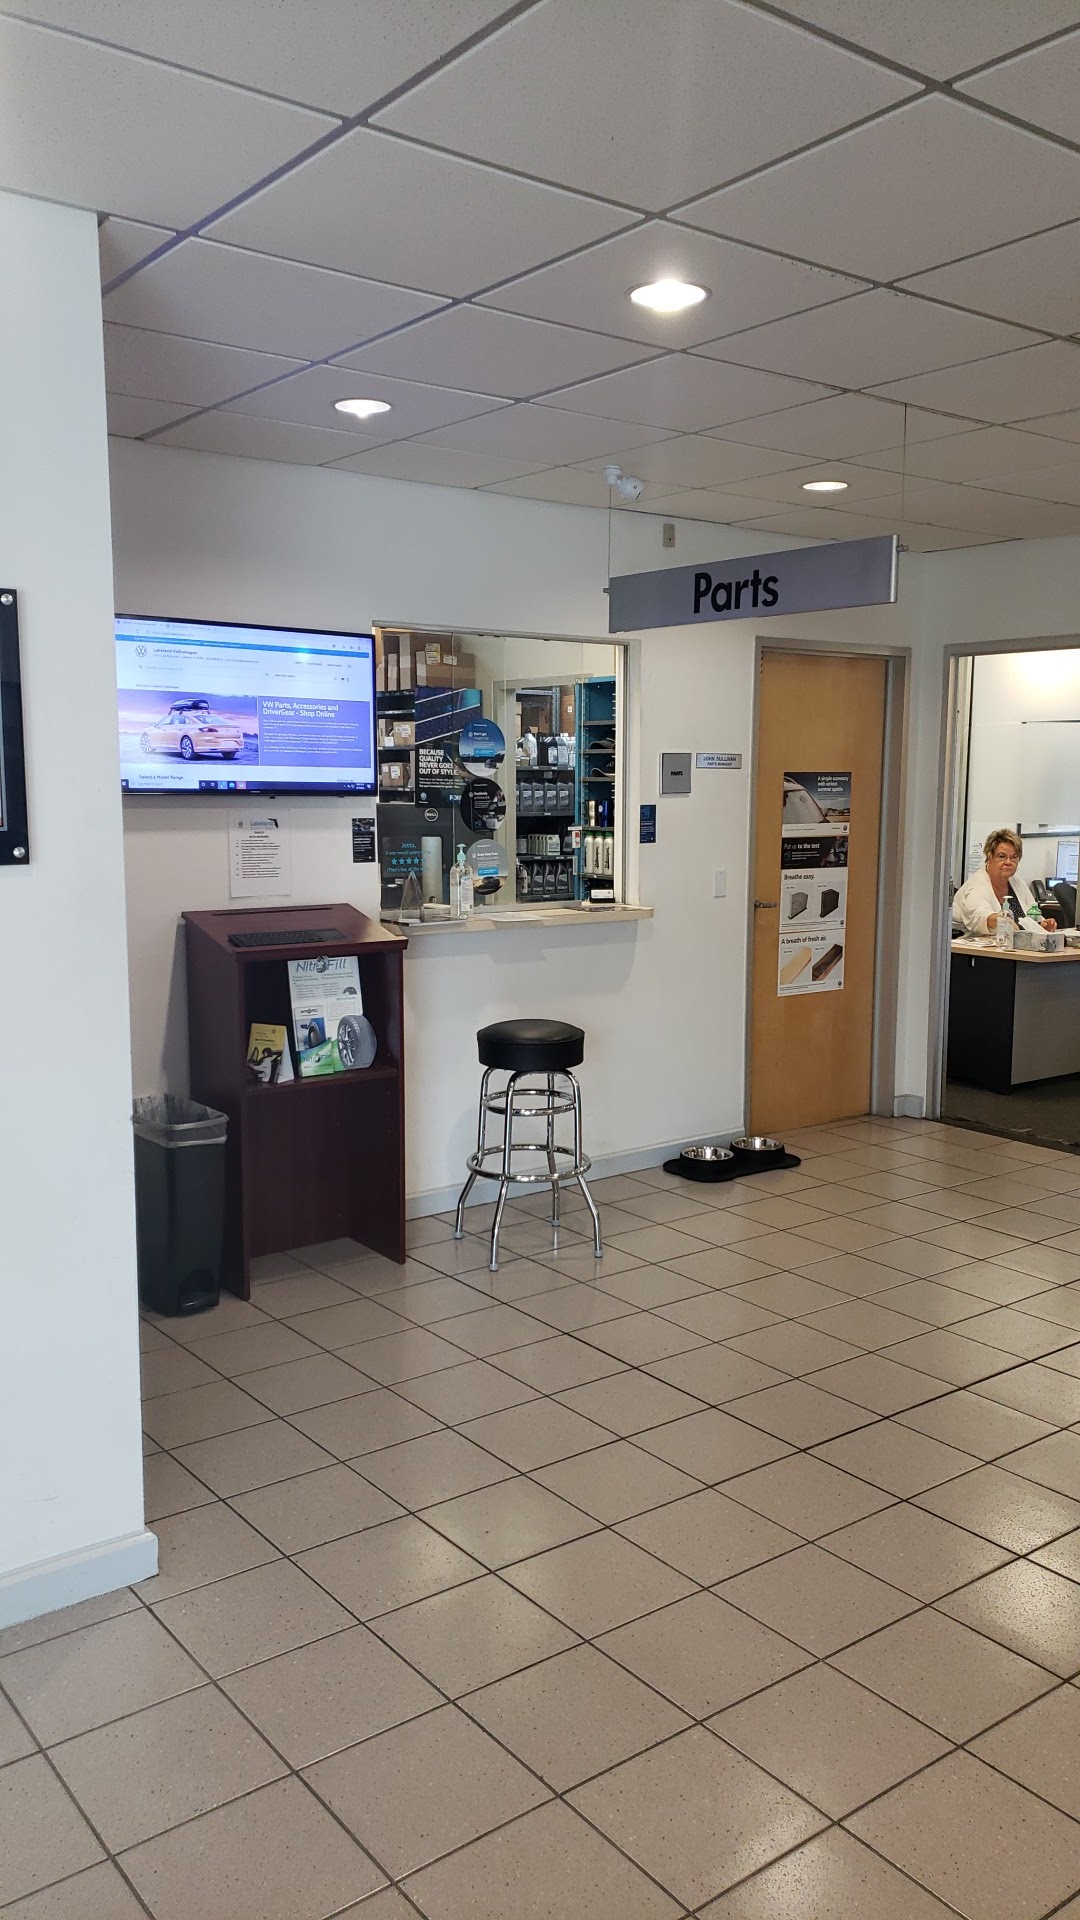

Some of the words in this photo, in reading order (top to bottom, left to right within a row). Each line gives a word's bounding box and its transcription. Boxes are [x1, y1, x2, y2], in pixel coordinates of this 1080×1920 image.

[693, 569, 779, 614] Parts
[293, 703, 327, 711] Accessories
[263, 708, 295, 716] DriverGear
[300, 710, 315, 718] Shop
